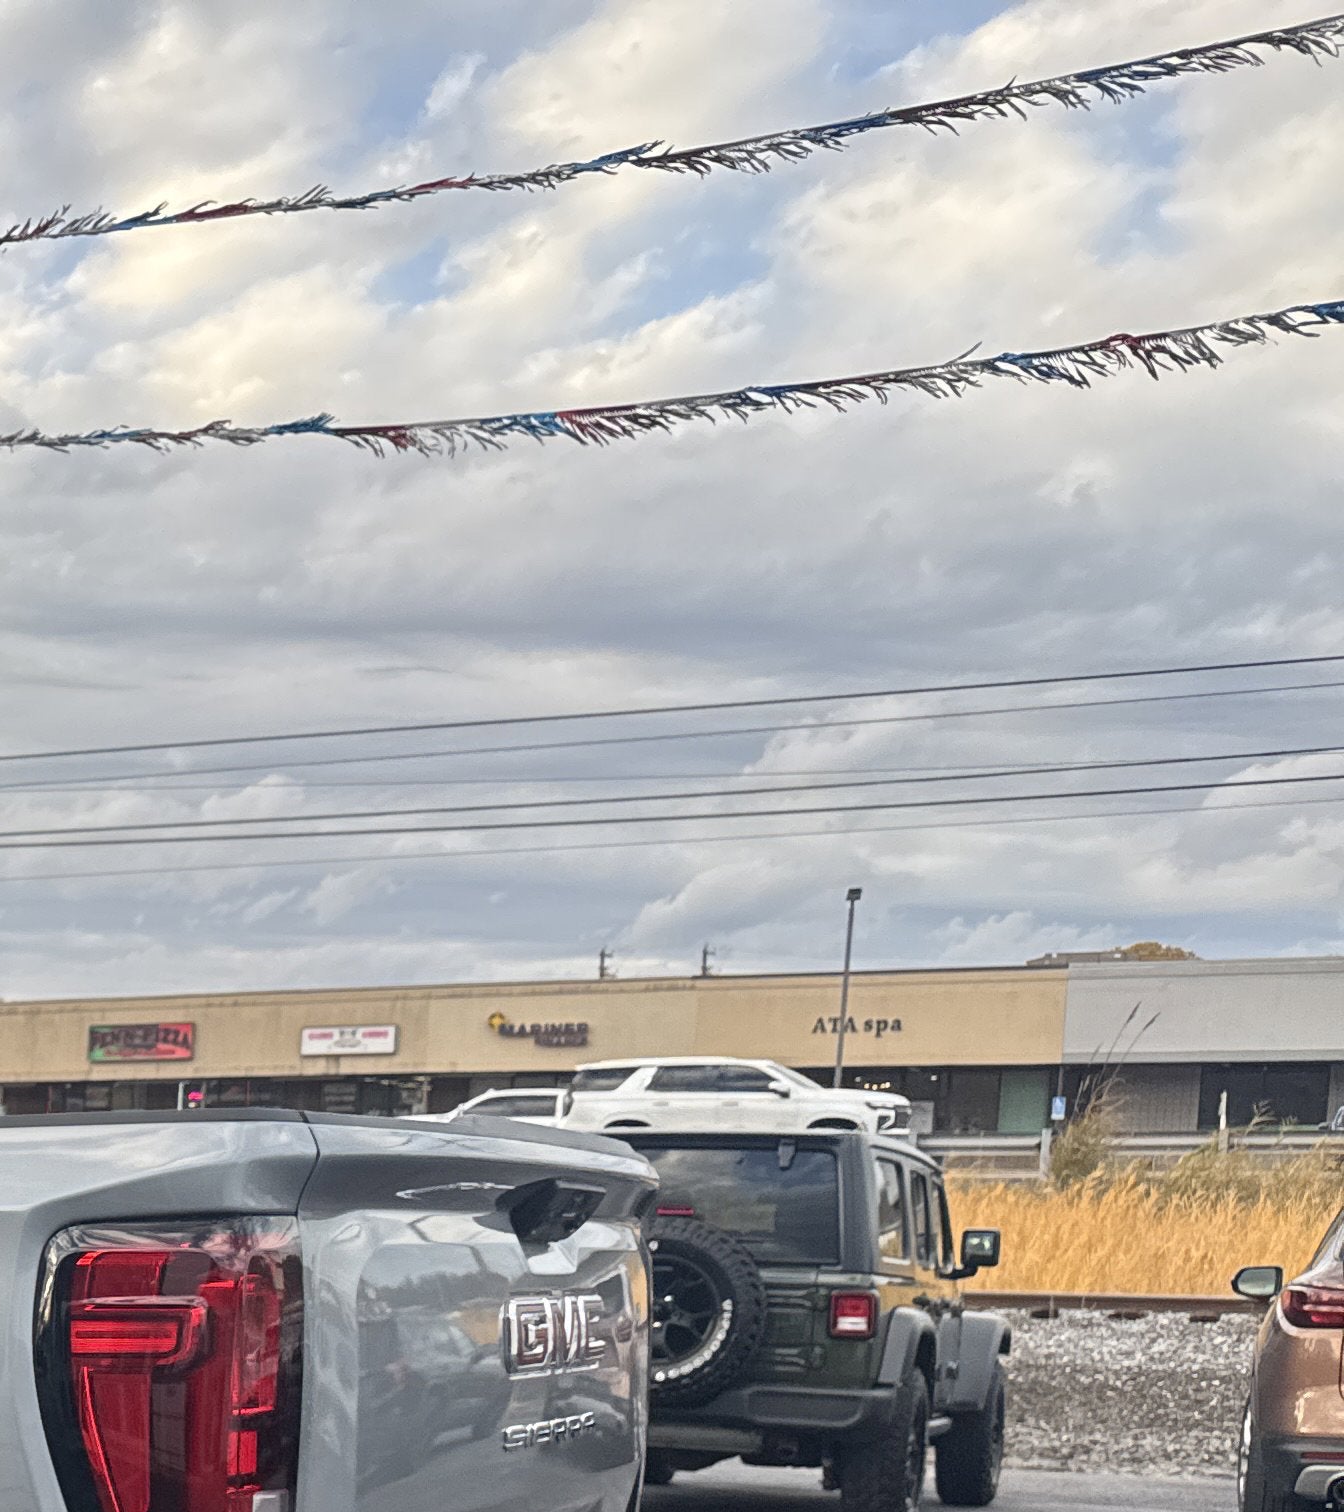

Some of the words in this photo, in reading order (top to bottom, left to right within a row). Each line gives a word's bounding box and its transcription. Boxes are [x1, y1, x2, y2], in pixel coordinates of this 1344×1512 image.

[498, 1022, 589, 1037] MARINER
[811, 1016, 858, 1034] ATA
[863, 1018, 903, 1038] spa
[502, 1294, 606, 1378] GMC
[502, 1411, 596, 1450] SIERRA
